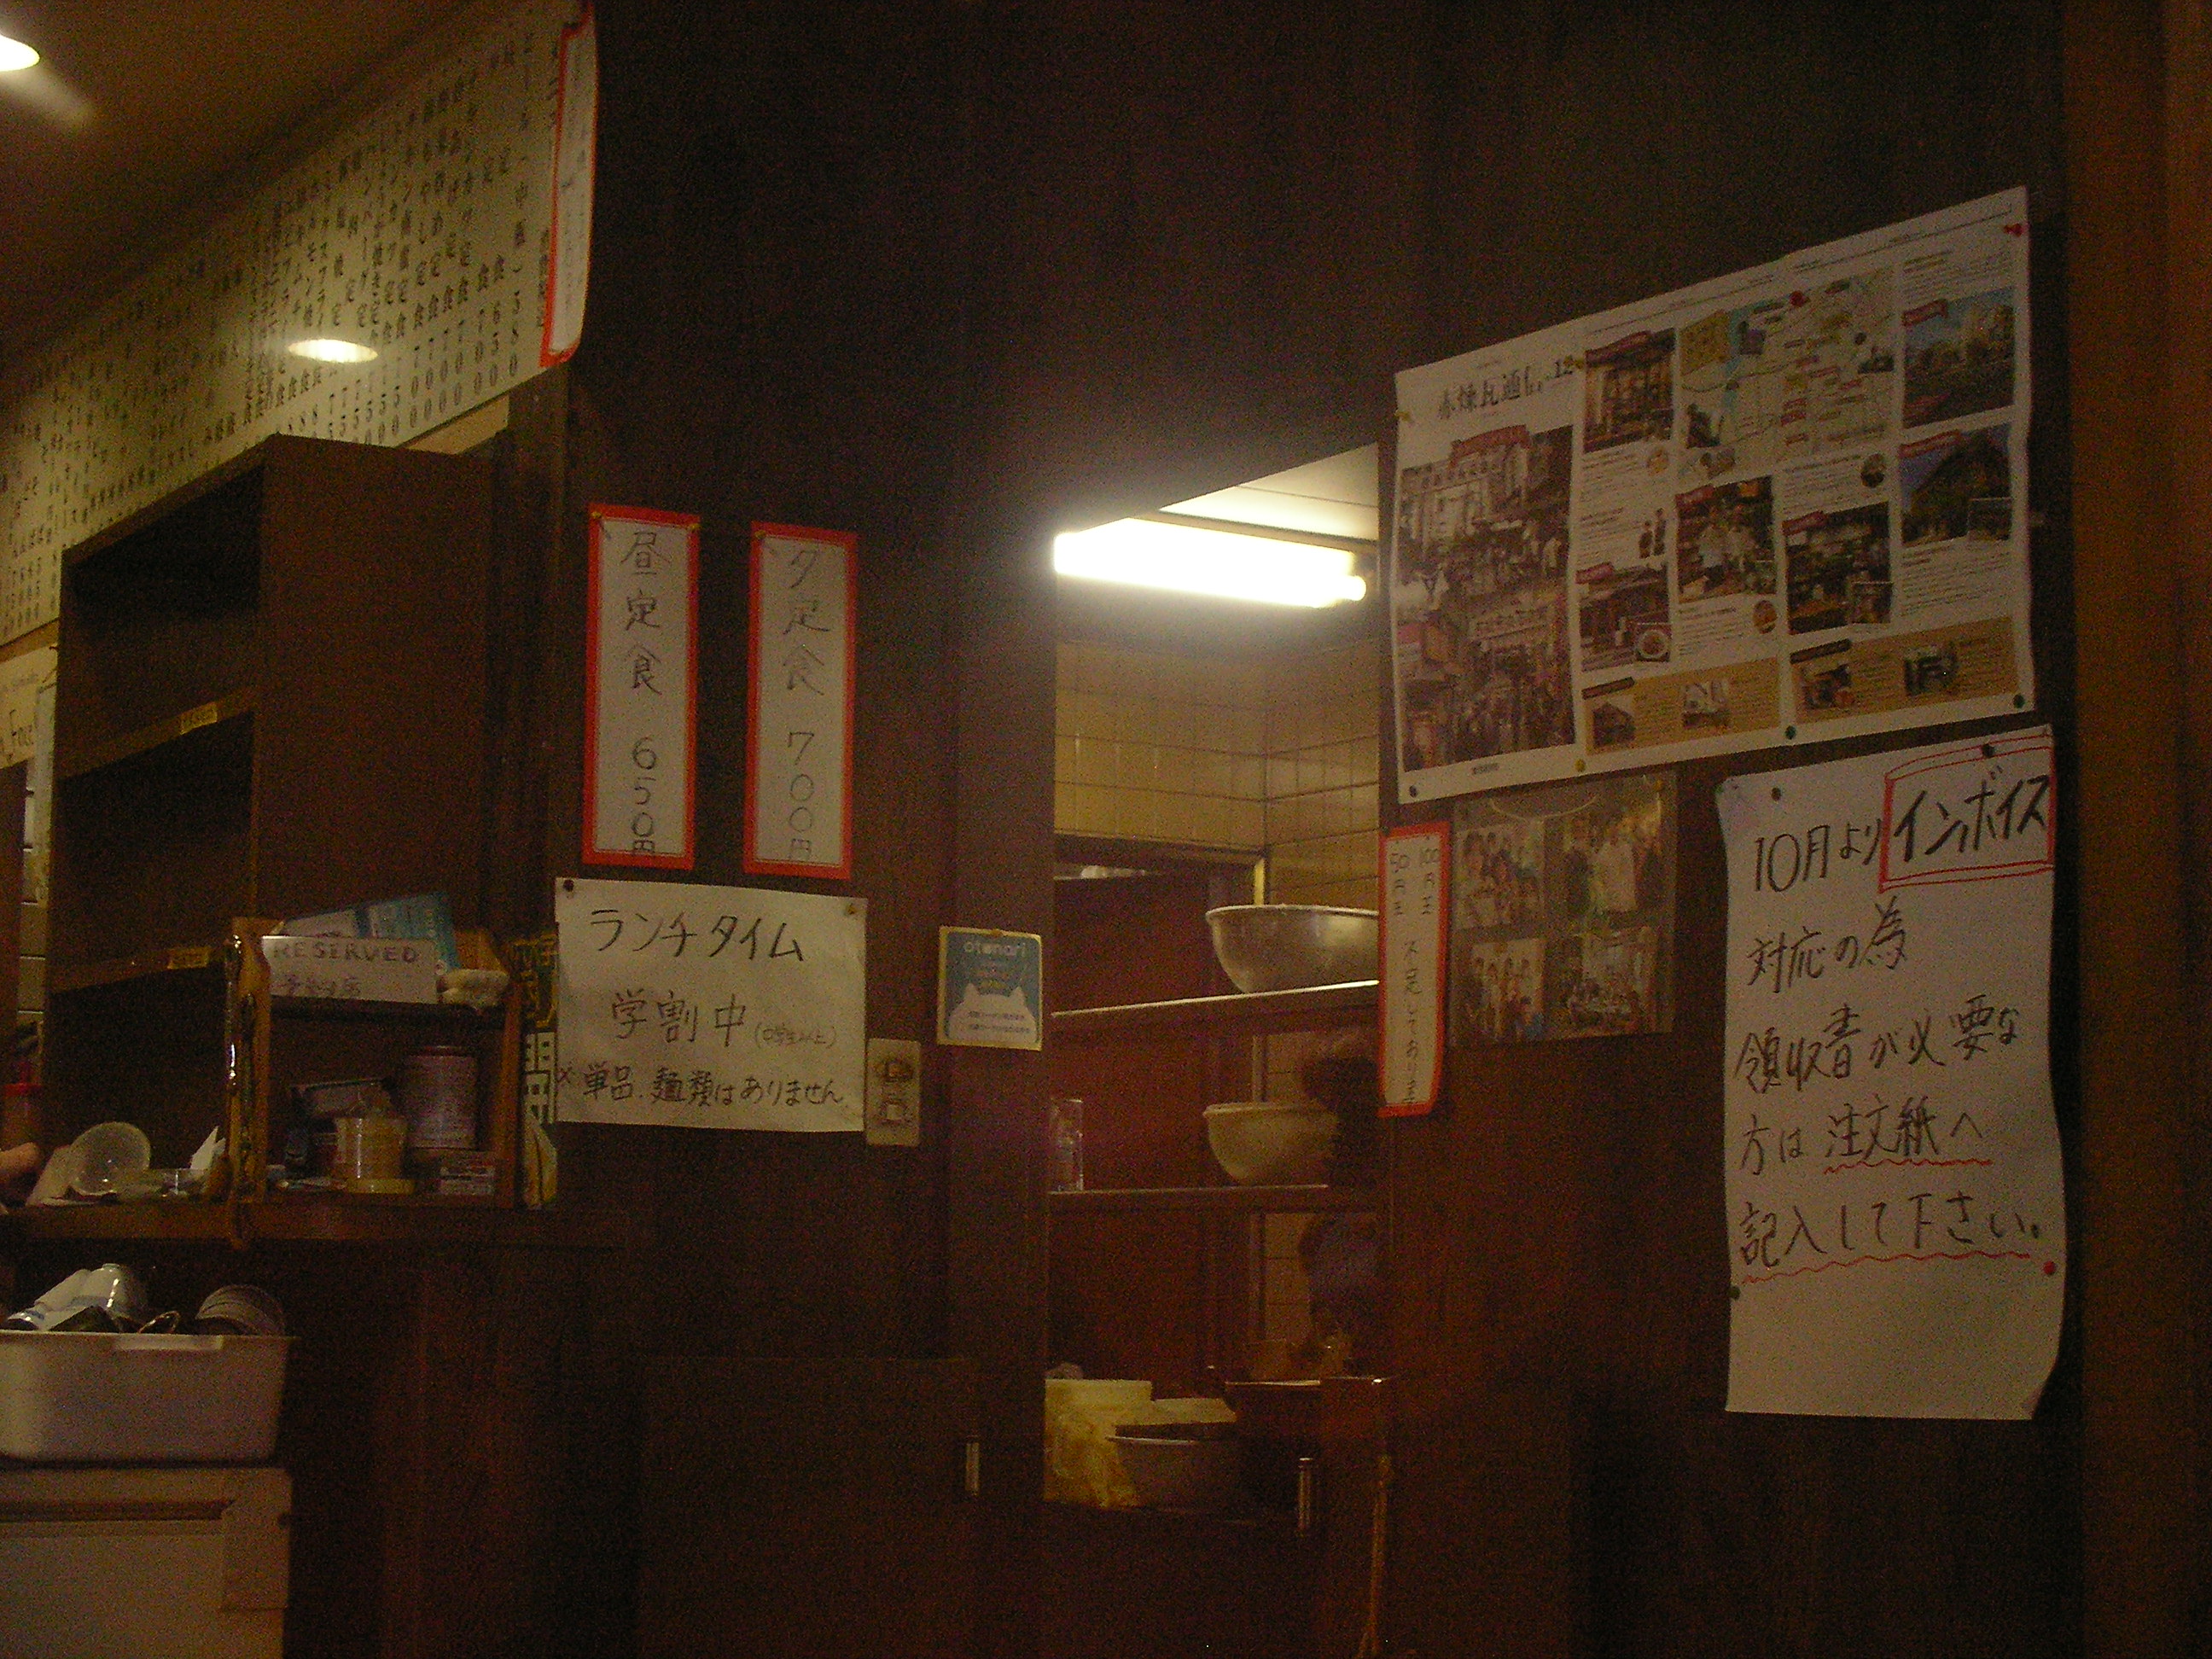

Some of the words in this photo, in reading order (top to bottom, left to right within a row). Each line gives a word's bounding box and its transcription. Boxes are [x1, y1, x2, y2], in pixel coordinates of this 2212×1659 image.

[620, 531, 670, 696] 昼定食
[782, 549, 830, 697] 夕定食
[272, 940, 418, 963] RESERVED
[590, 907, 805, 962] ランチタイム
[1749, 903, 1908, 993] 対応の為
[611, 990, 747, 1048] 学割中
